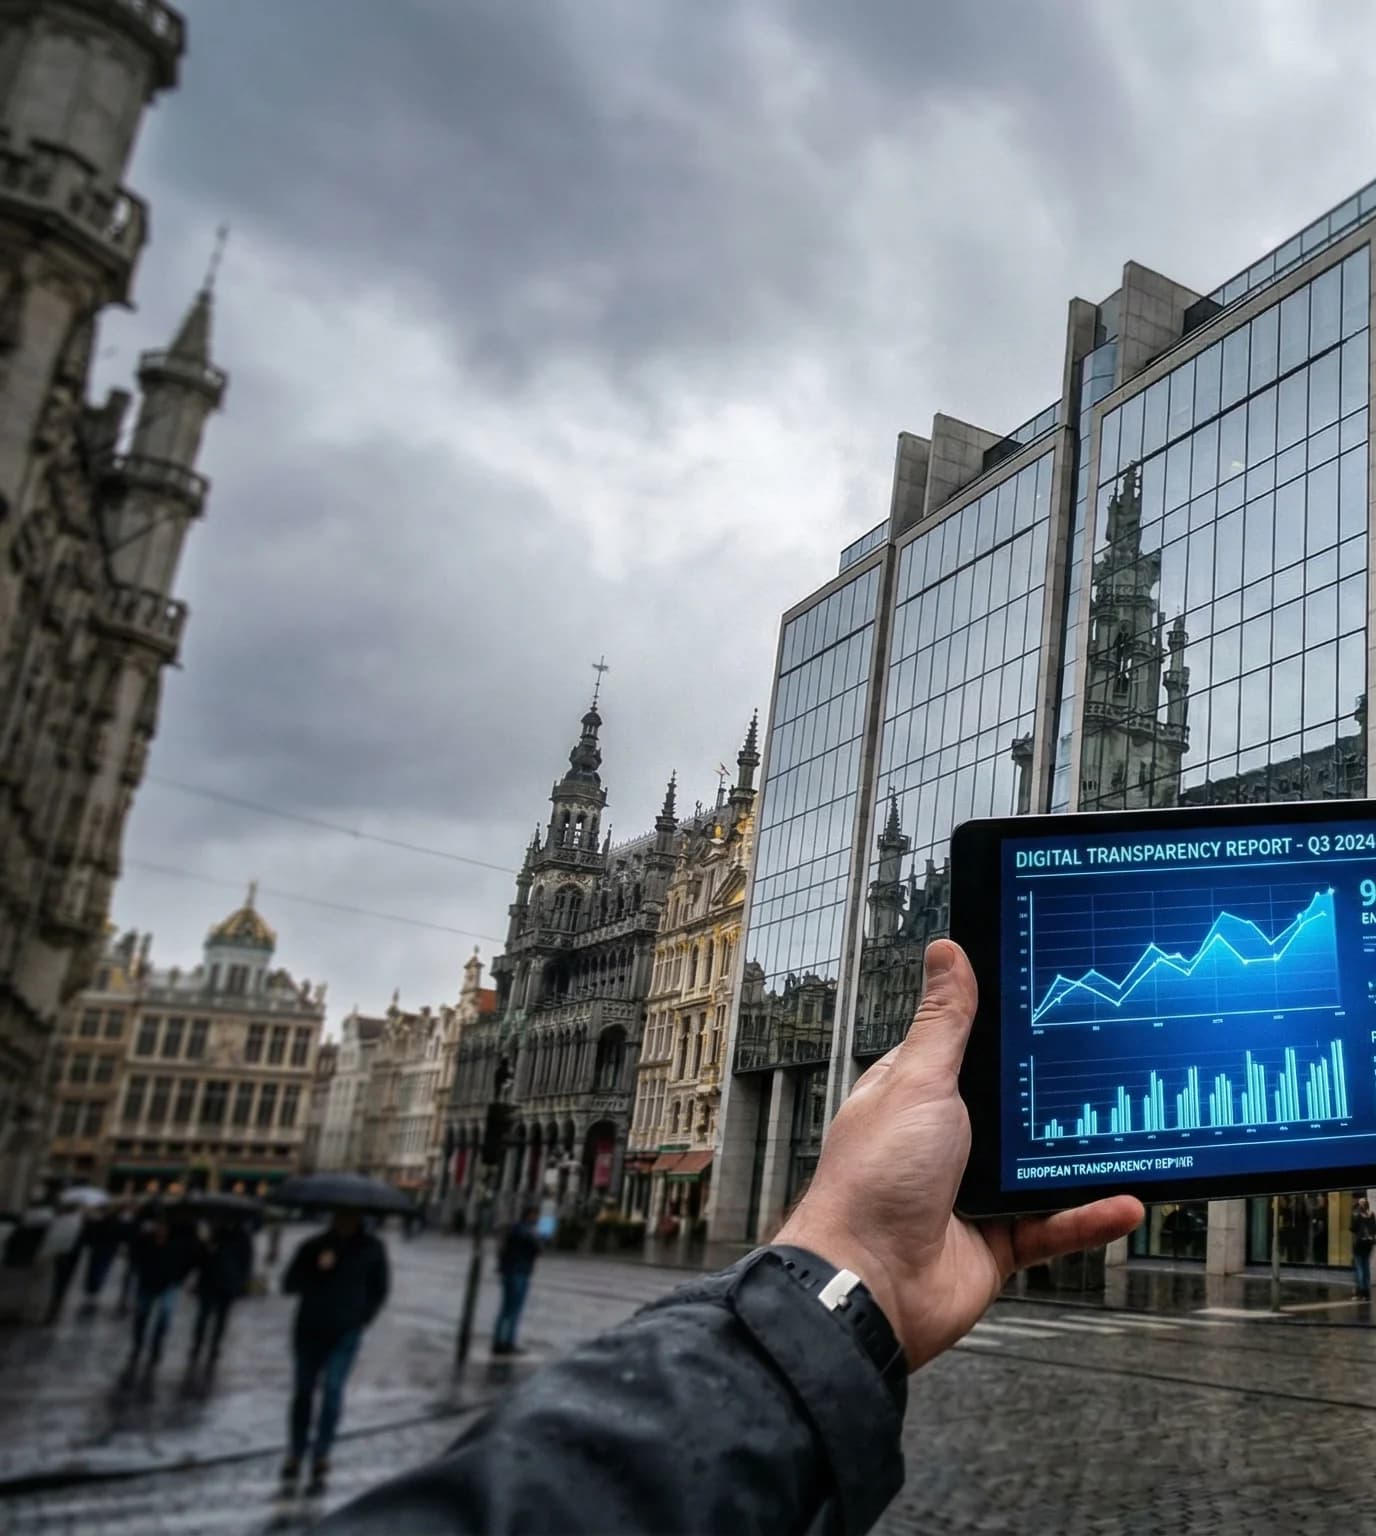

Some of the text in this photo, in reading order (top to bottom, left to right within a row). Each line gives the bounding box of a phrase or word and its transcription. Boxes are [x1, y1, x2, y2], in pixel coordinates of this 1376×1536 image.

[1016, 849, 1082, 868] DIGITAL
[1086, 842, 1221, 864] TRANSPARENCY
[1226, 838, 1293, 857] REPORT
[1308, 835, 1330, 855] Q3
[1334, 833, 1376, 851] 2024
[1017, 1164, 1071, 1179] EUROPEAN
[1072, 1158, 1153, 1175] TRANSPARENCY
